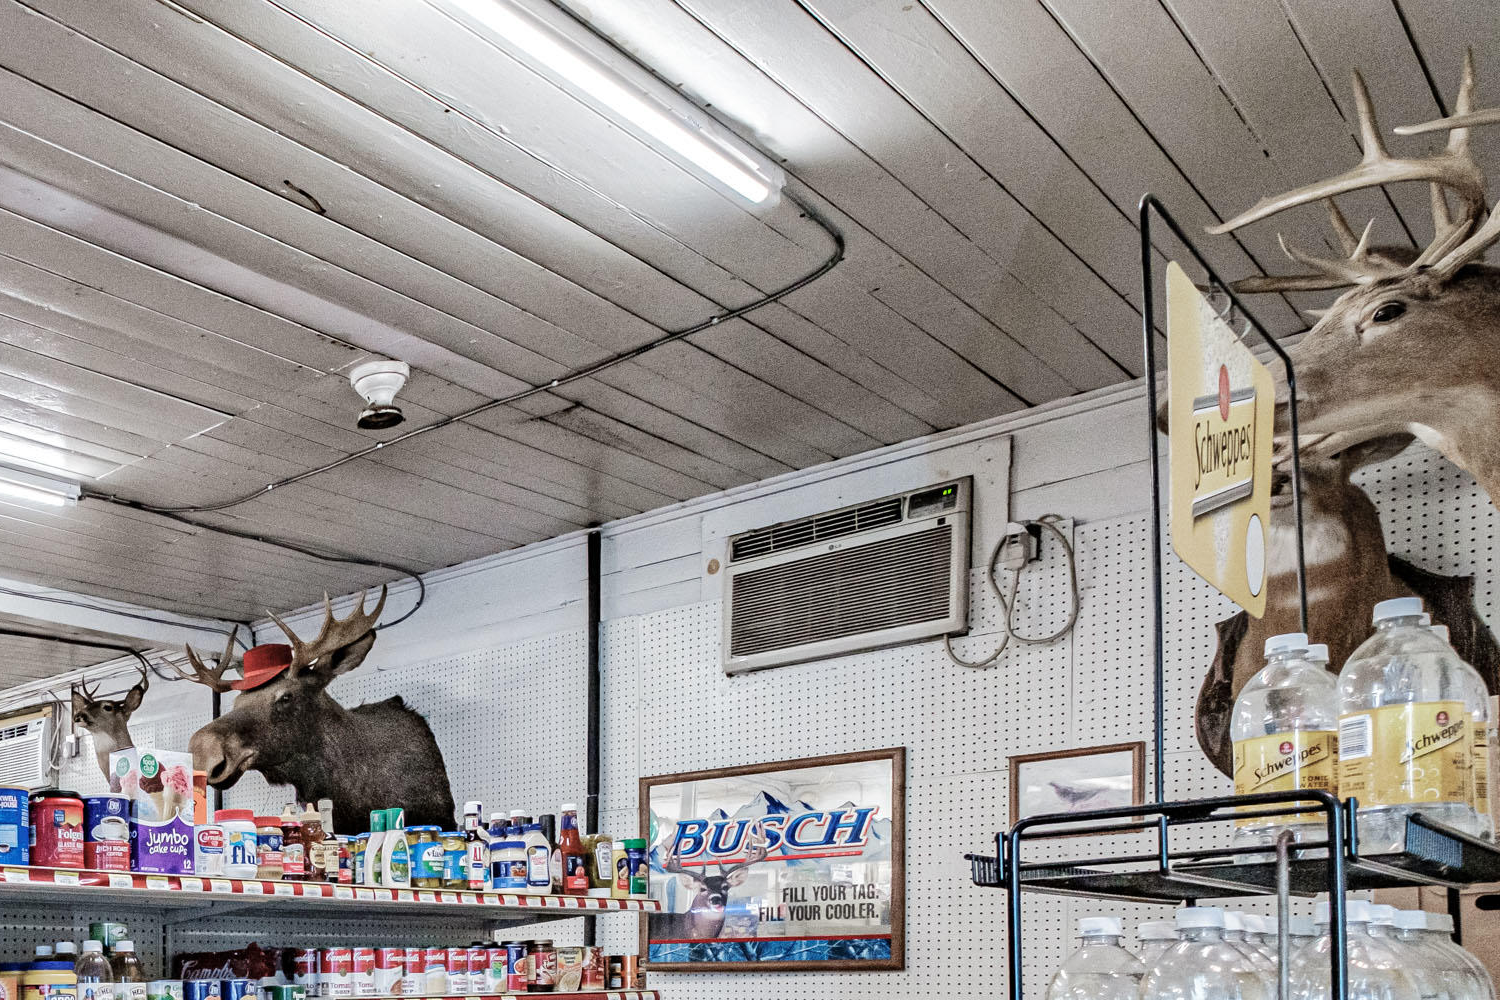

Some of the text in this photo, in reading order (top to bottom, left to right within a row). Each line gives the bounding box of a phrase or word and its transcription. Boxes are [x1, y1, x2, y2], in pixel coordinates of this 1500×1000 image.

[1195, 420, 1251, 490] Schweppes
[146, 829, 189, 847] jumbo
[673, 807, 879, 858] BUSCH
[149, 845, 188, 856] cake cups
[183, 859, 192, 869] 12
[782, 882, 880, 904] FILL YOUR TAG.
[758, 904, 786, 922] FILL
[788, 903, 822, 921] YOUR
